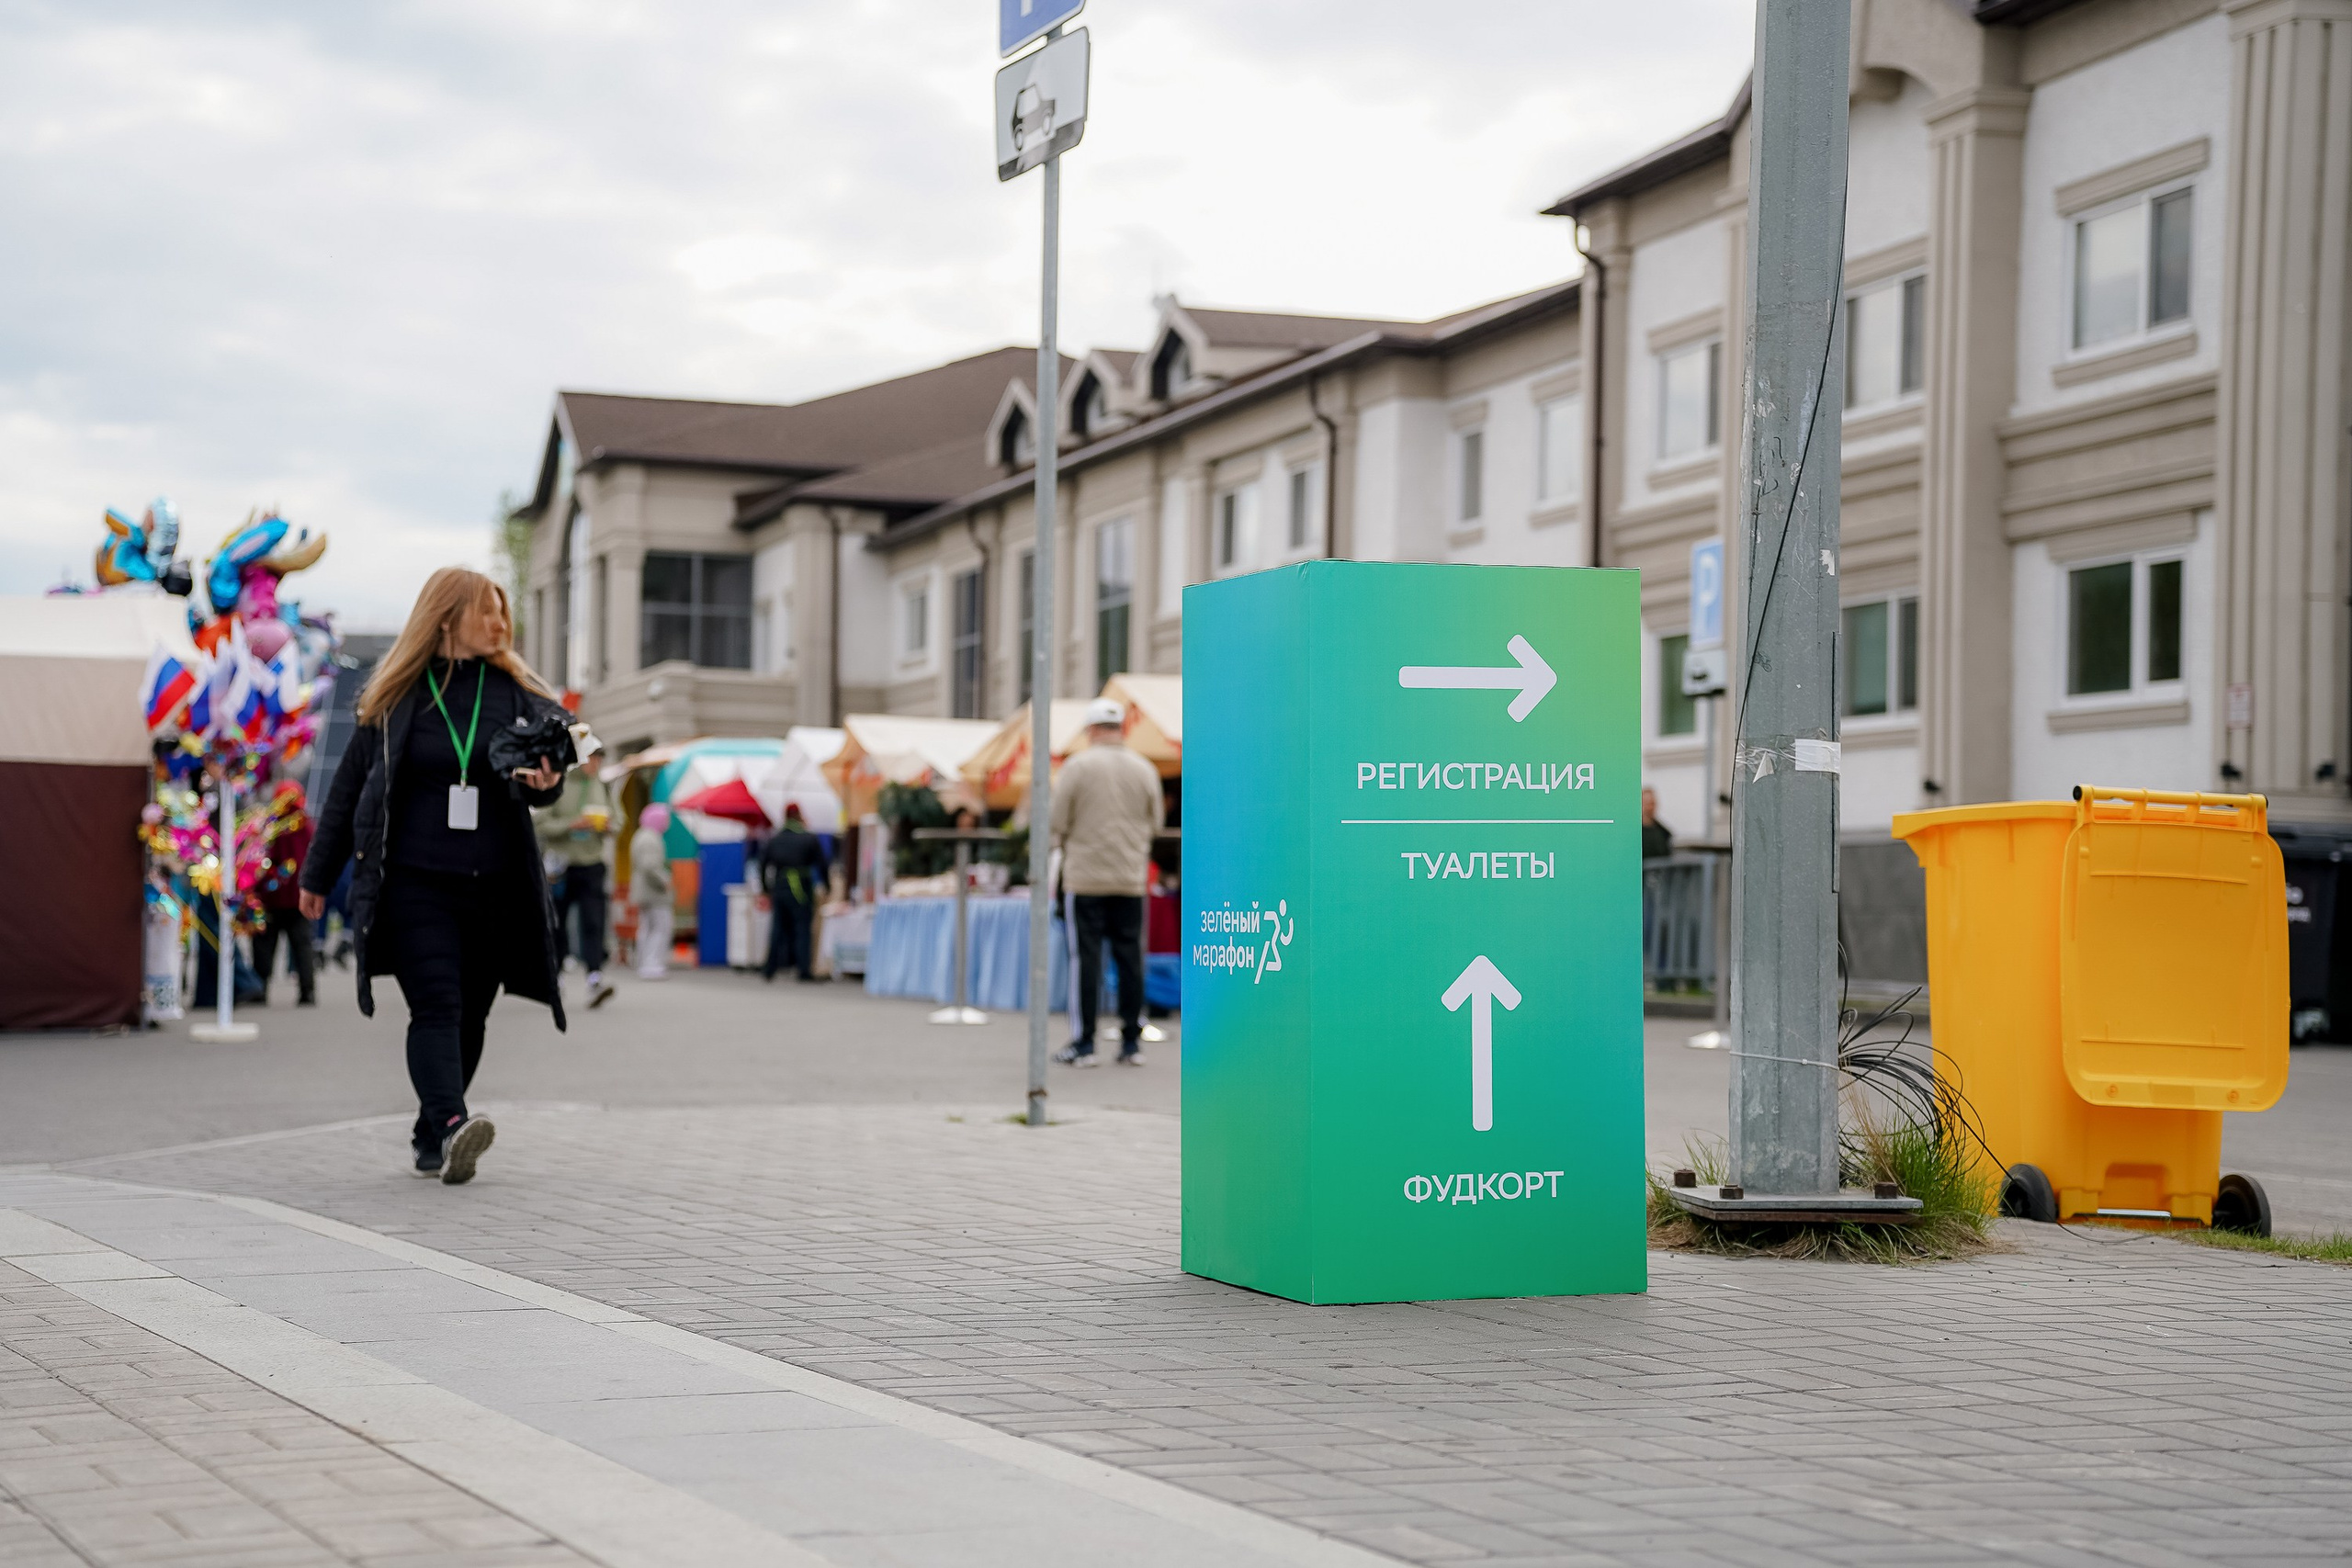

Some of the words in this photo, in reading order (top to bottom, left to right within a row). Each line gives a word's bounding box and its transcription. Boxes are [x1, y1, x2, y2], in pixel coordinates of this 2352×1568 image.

[1357, 762, 1595, 795] РЕГИСТРАЦИЯ
[1400, 852, 1555, 879] ТУАЛЕТЫ
[1200, 901, 1260, 933] зелёный
[1193, 935, 1255, 975] марафон
[1403, 1170, 1565, 1206] ФУДКОРТ
